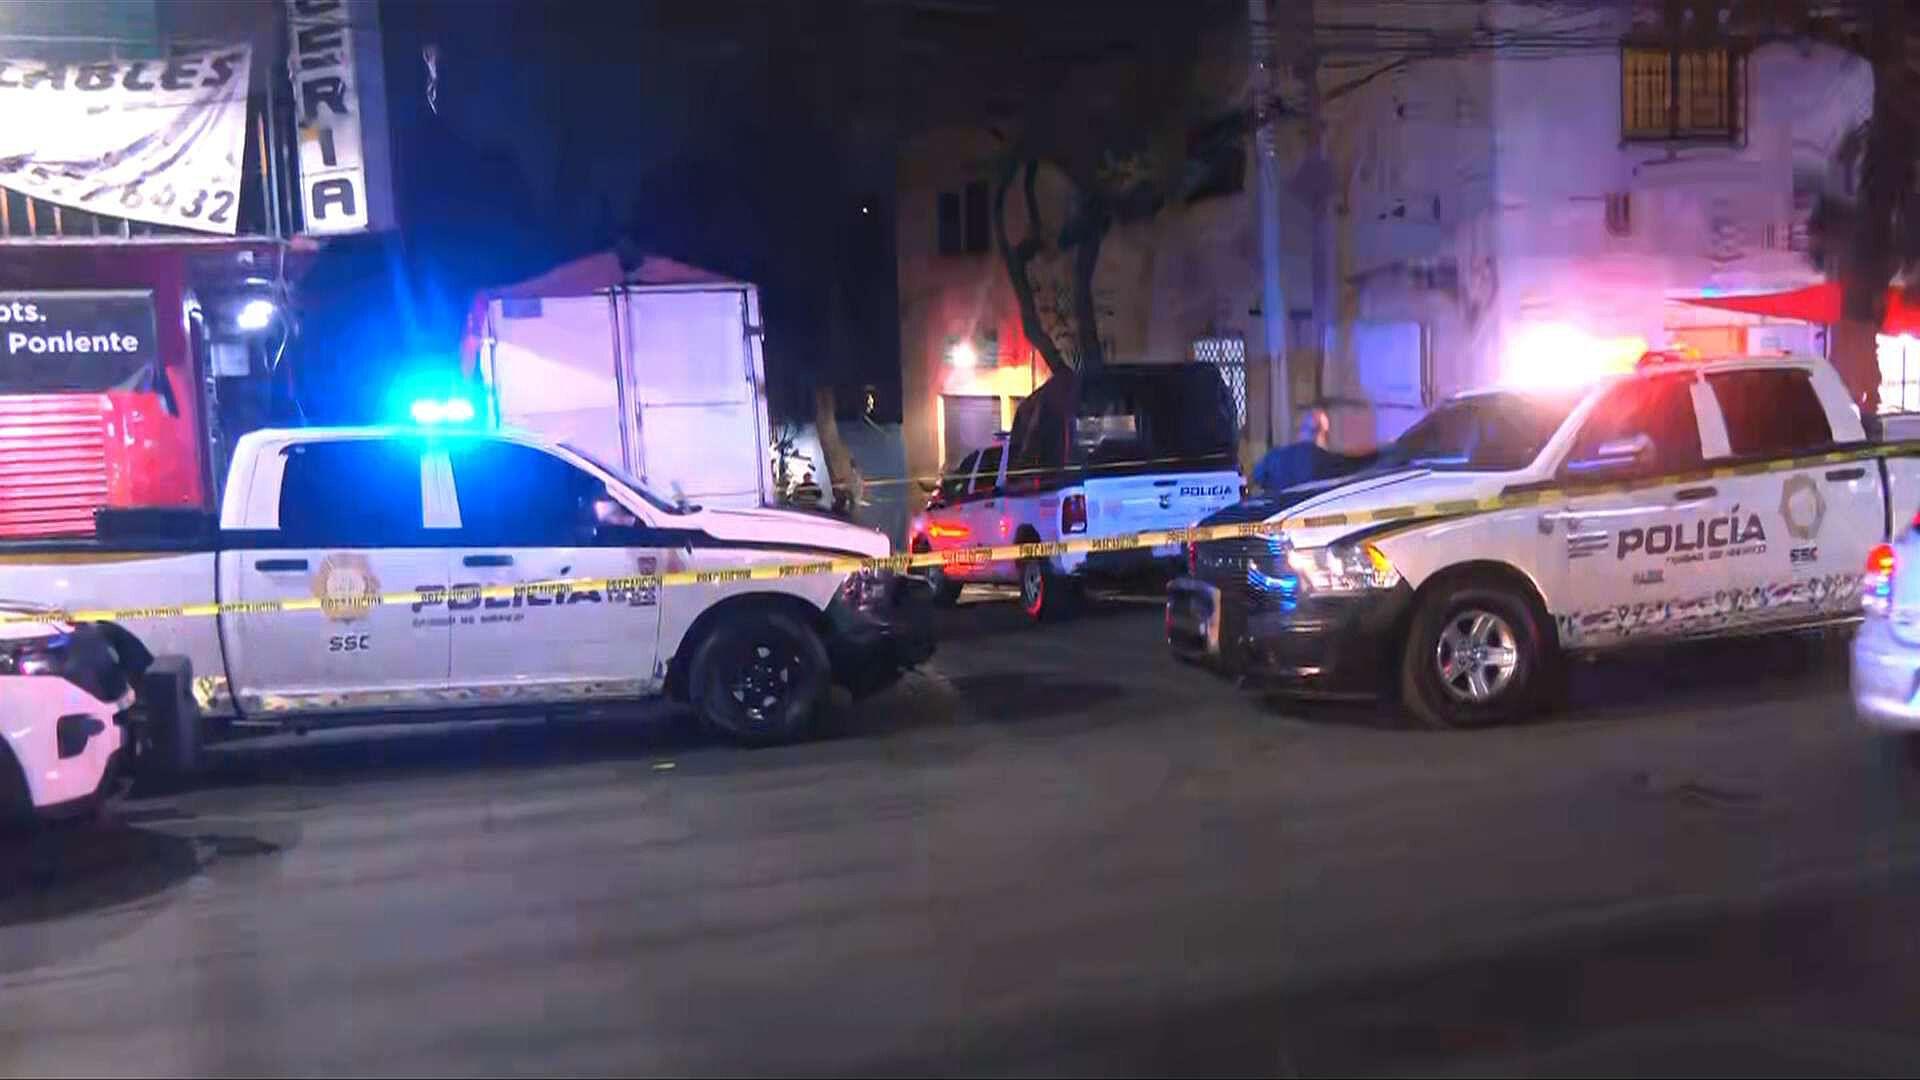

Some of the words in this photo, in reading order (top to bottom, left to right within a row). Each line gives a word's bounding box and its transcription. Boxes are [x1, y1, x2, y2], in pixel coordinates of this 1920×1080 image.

[8, 329, 139, 355] Poniente
[1617, 503, 1767, 561] POLICÍA
[328, 635, 371, 652] SSC
